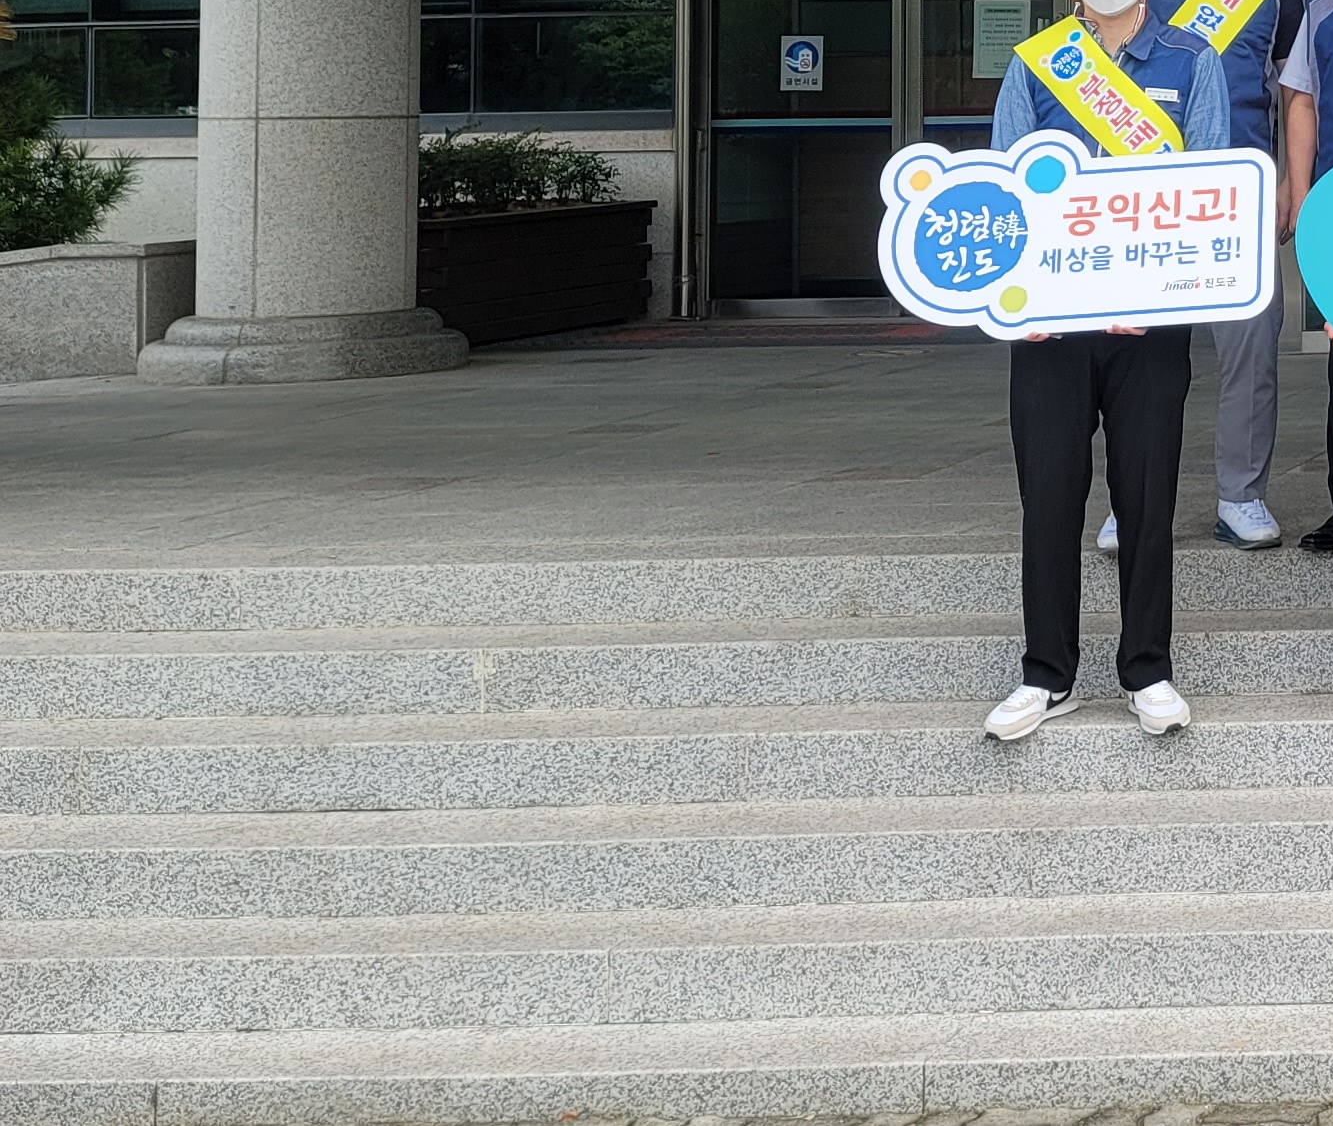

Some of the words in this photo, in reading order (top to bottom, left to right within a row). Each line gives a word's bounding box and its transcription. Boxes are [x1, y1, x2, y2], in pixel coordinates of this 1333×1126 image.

[785, 77, 818, 86] 금연시설
[1079, 74, 1158, 150] 부정부패
[1063, 187, 1237, 236] 공익신고!
[937, 246, 1000, 284] 진도
[1039, 245, 1114, 274] 세상을
[1125, 240, 1200, 268] 바꾸는
[1211, 236, 1241, 262] 힘!
[1161, 277, 1198, 291] Jindo
[1205, 276, 1237, 288] 진도군
